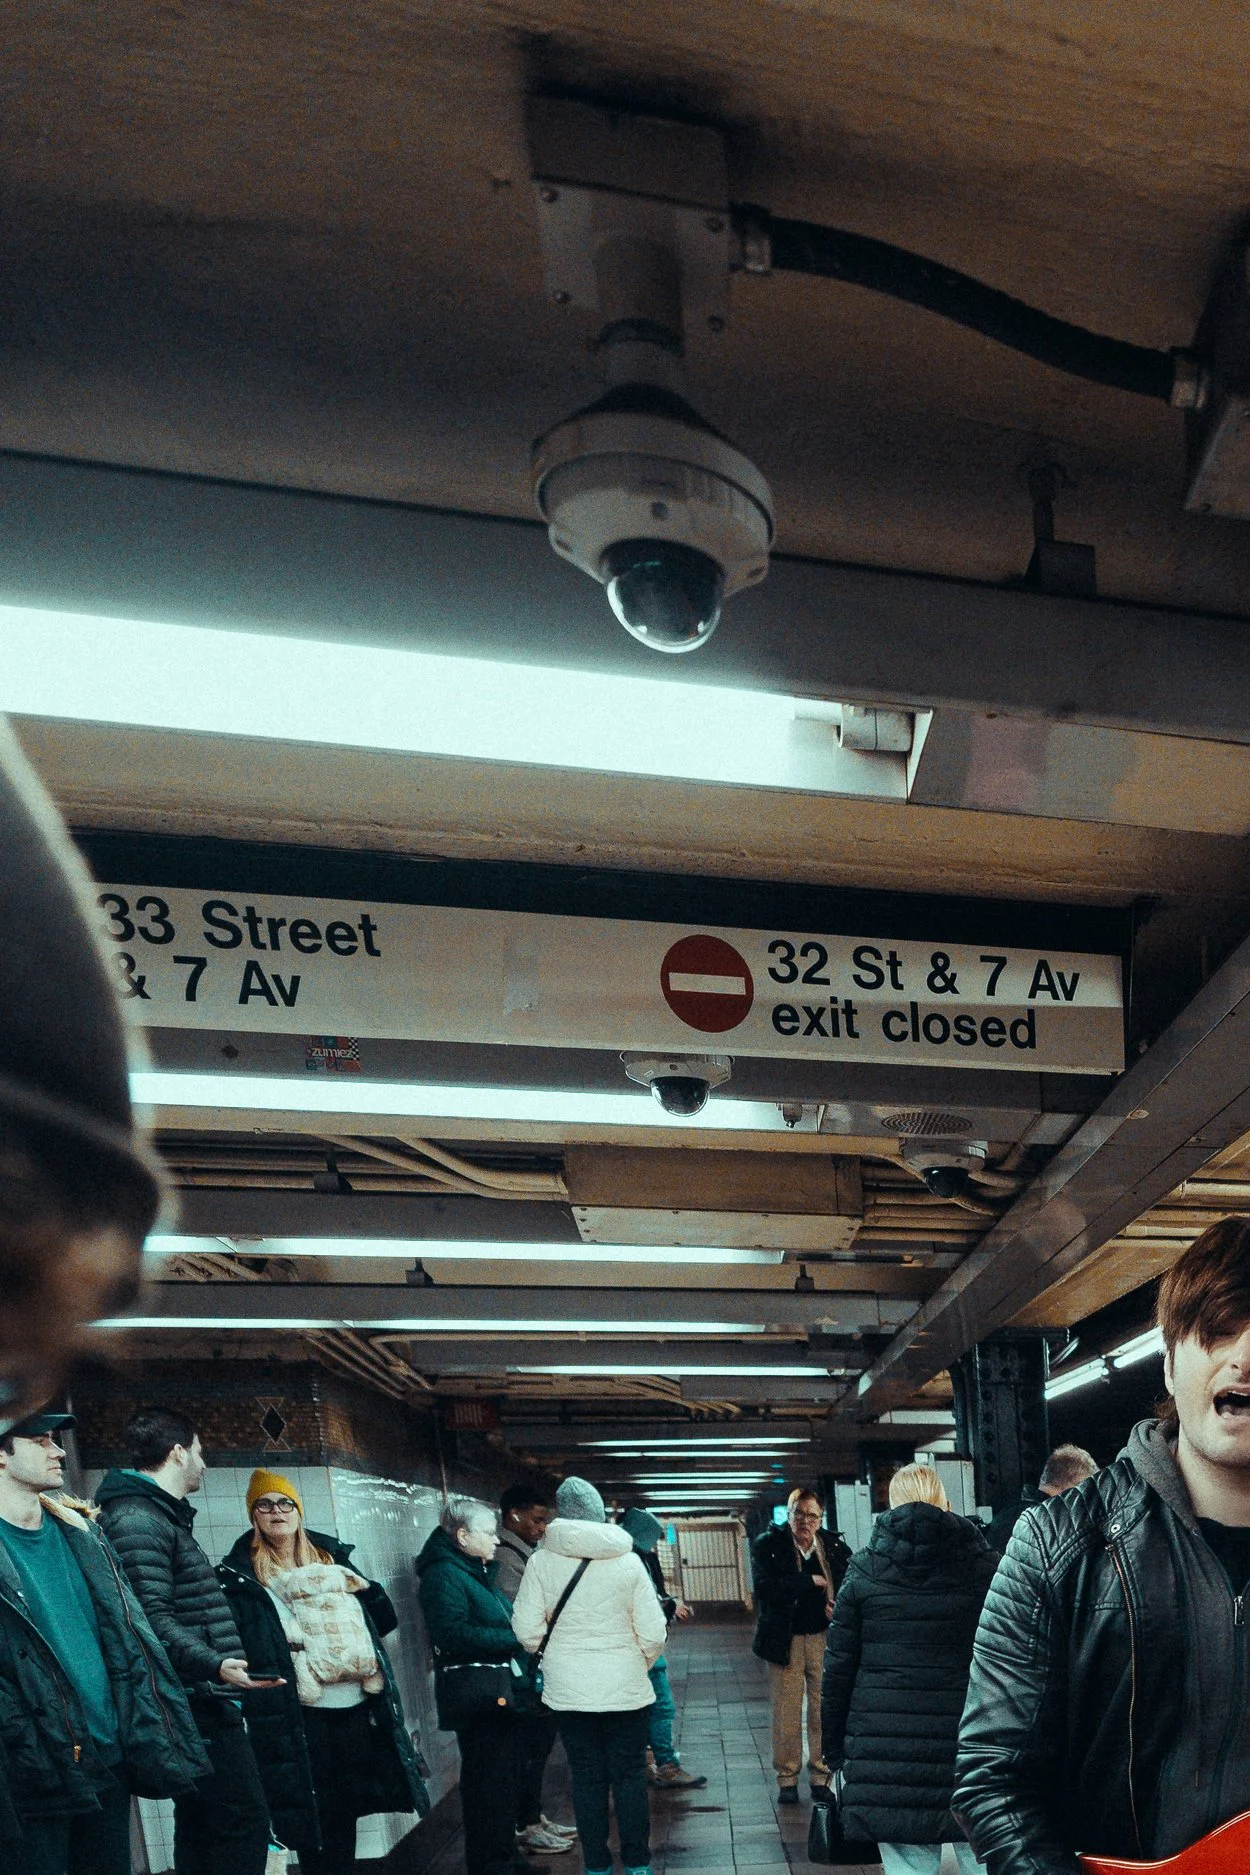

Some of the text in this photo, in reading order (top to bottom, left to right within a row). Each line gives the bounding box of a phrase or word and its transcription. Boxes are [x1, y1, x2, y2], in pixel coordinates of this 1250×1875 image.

[98, 893, 382, 958] 33 Street
[112, 950, 301, 1008] & 7 Av
[767, 939, 1081, 1001] 32 St & 7 Av
[771, 996, 1037, 1049] exit closed
